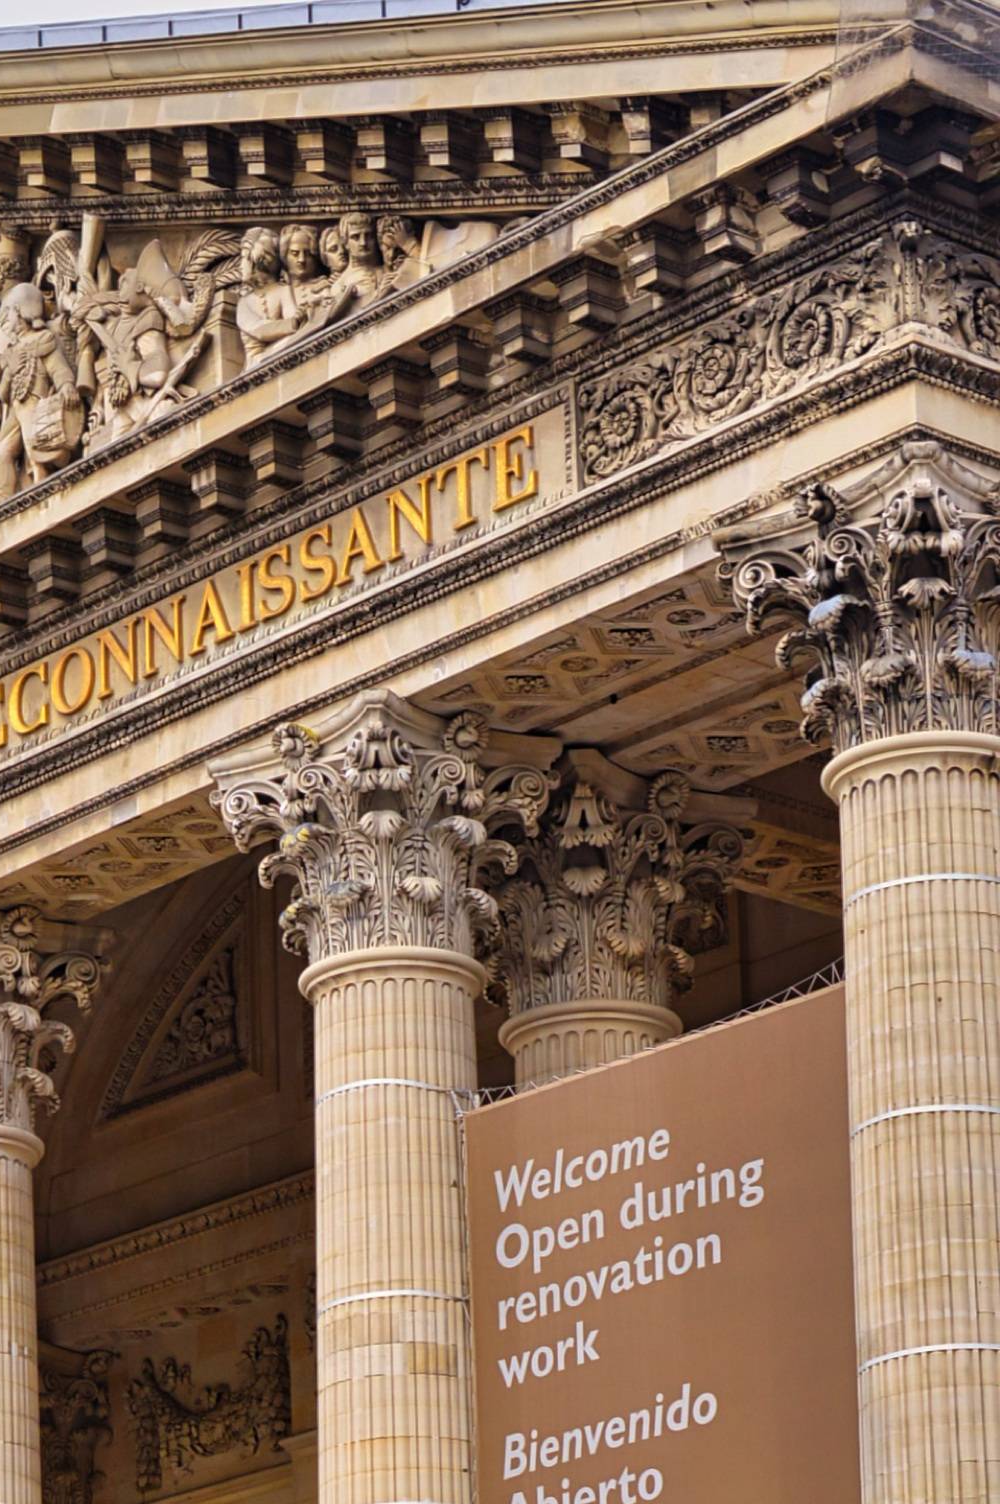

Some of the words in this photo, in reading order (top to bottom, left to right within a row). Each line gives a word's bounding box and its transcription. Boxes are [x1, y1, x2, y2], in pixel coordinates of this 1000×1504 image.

[494, 1127, 671, 1212] Welcome
[495, 1204, 605, 1276] Open
[620, 1157, 765, 1231] during
[497, 1234, 722, 1330] renovation
[498, 1321, 601, 1388] work
[503, 1383, 718, 1481] Bienvenido
